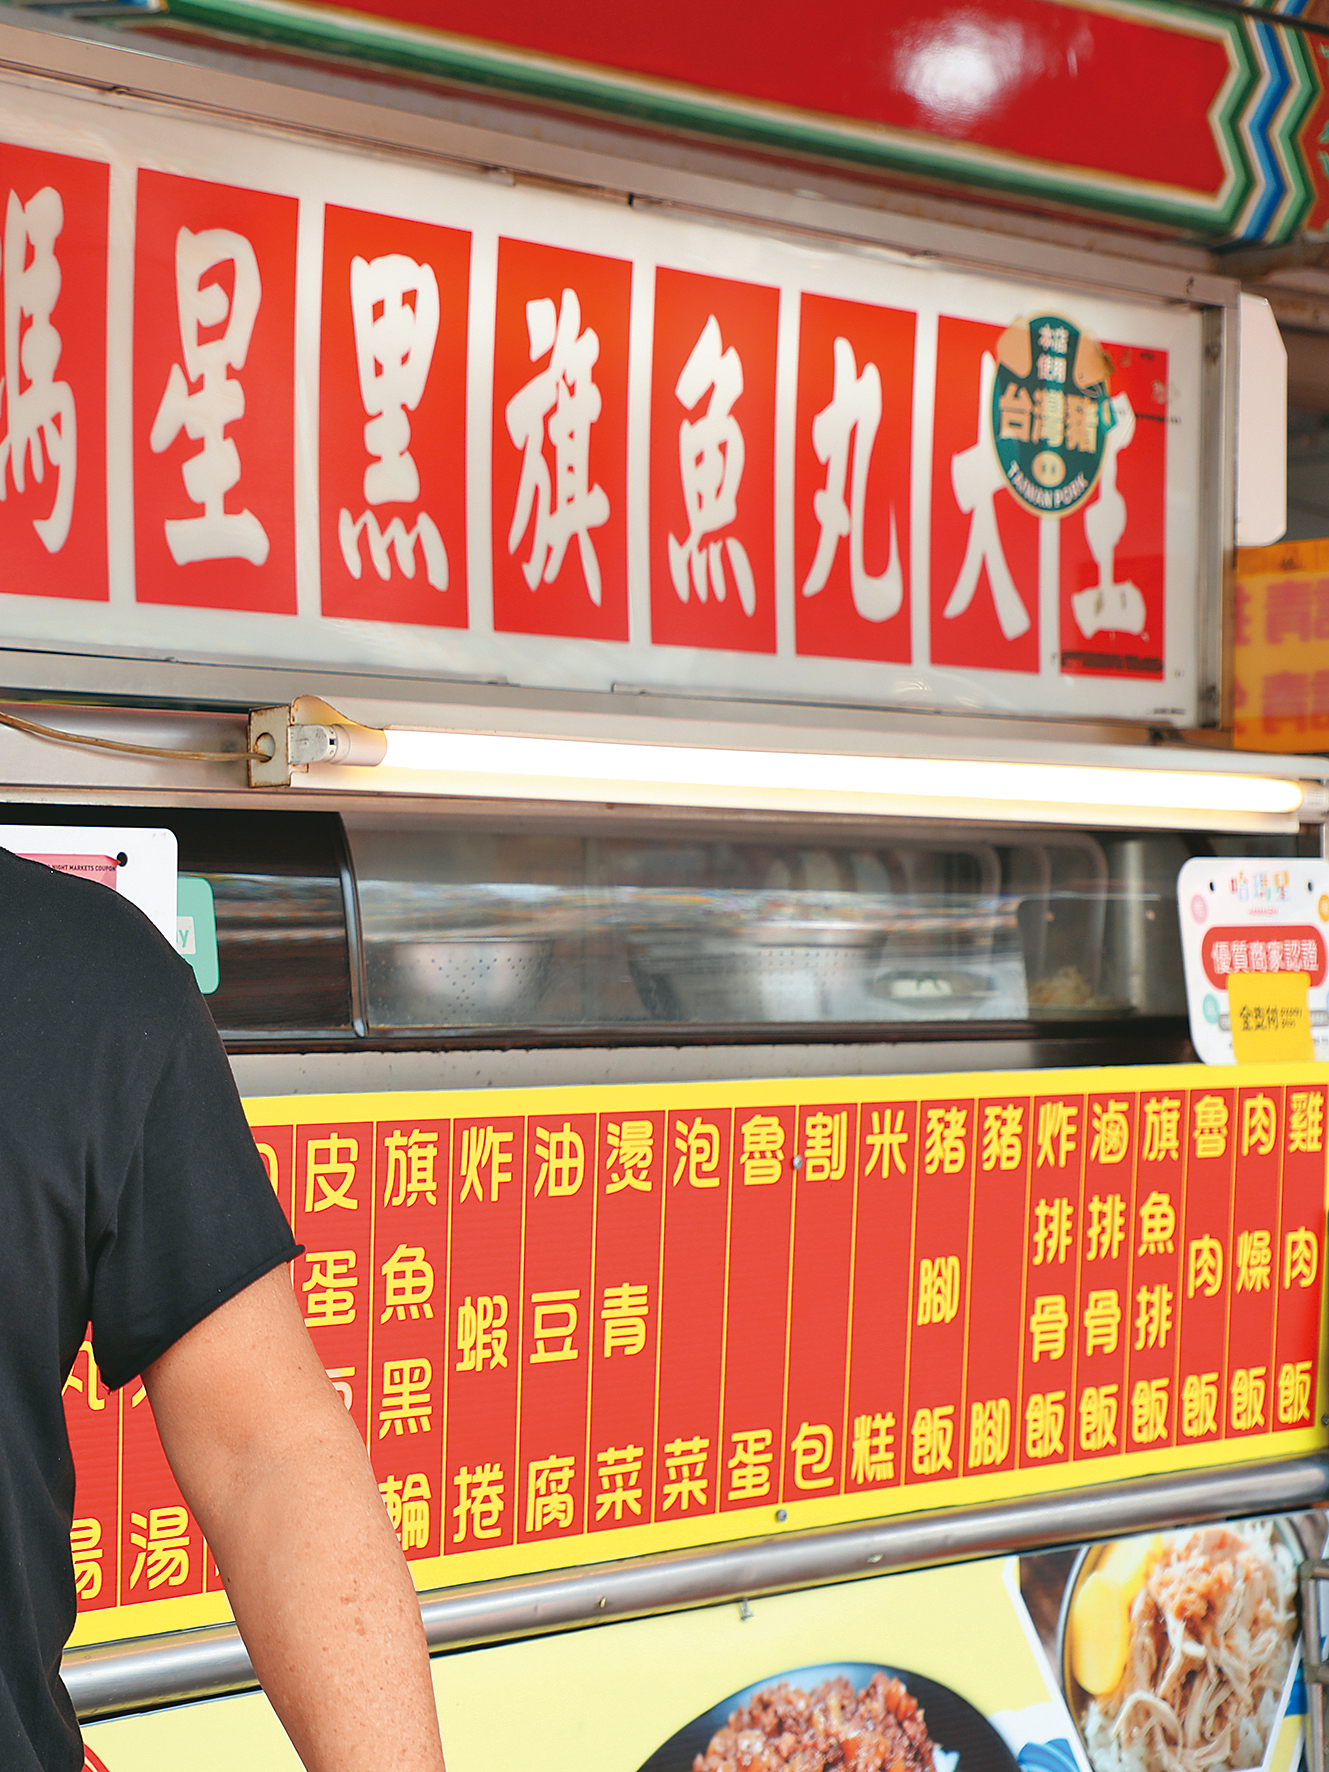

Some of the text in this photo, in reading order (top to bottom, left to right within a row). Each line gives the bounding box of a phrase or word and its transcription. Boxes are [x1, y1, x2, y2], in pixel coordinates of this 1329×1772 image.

[999, 382, 1099, 454] 台灣豬
[1007, 460, 1089, 509] TAIWAN PORK
[1037, 353, 1068, 384] 使用
[1038, 324, 1069, 353] 本店
[1210, 939, 1320, 974] 優質商家認證
[378, 1128, 439, 1551] 旗魚黑輪
[454, 1126, 514, 1542] 炸蝦捲
[525, 1122, 585, 1533] 油豆腐
[596, 1120, 654, 1522] 燙青菜
[663, 1117, 721, 1511] 泡菜
[727, 1114, 786, 1501] 魯蛋
[790, 1111, 848, 1491] 割包
[852, 1108, 909, 1484] 米糕
[911, 1105, 967, 1476] 豬腳飯
[969, 1103, 1024, 1469] 豬腳
[1025, 1101, 1078, 1460] 炸排骨飯
[1079, 1099, 1131, 1452] 滷排骨飯
[1131, 1097, 1182, 1445] 旗魚排飯
[1181, 1094, 1229, 1438] 魯肉飯
[1230, 1092, 1277, 1431] 肉燥飯
[1277, 1090, 1324, 1426] 雞肉飯
